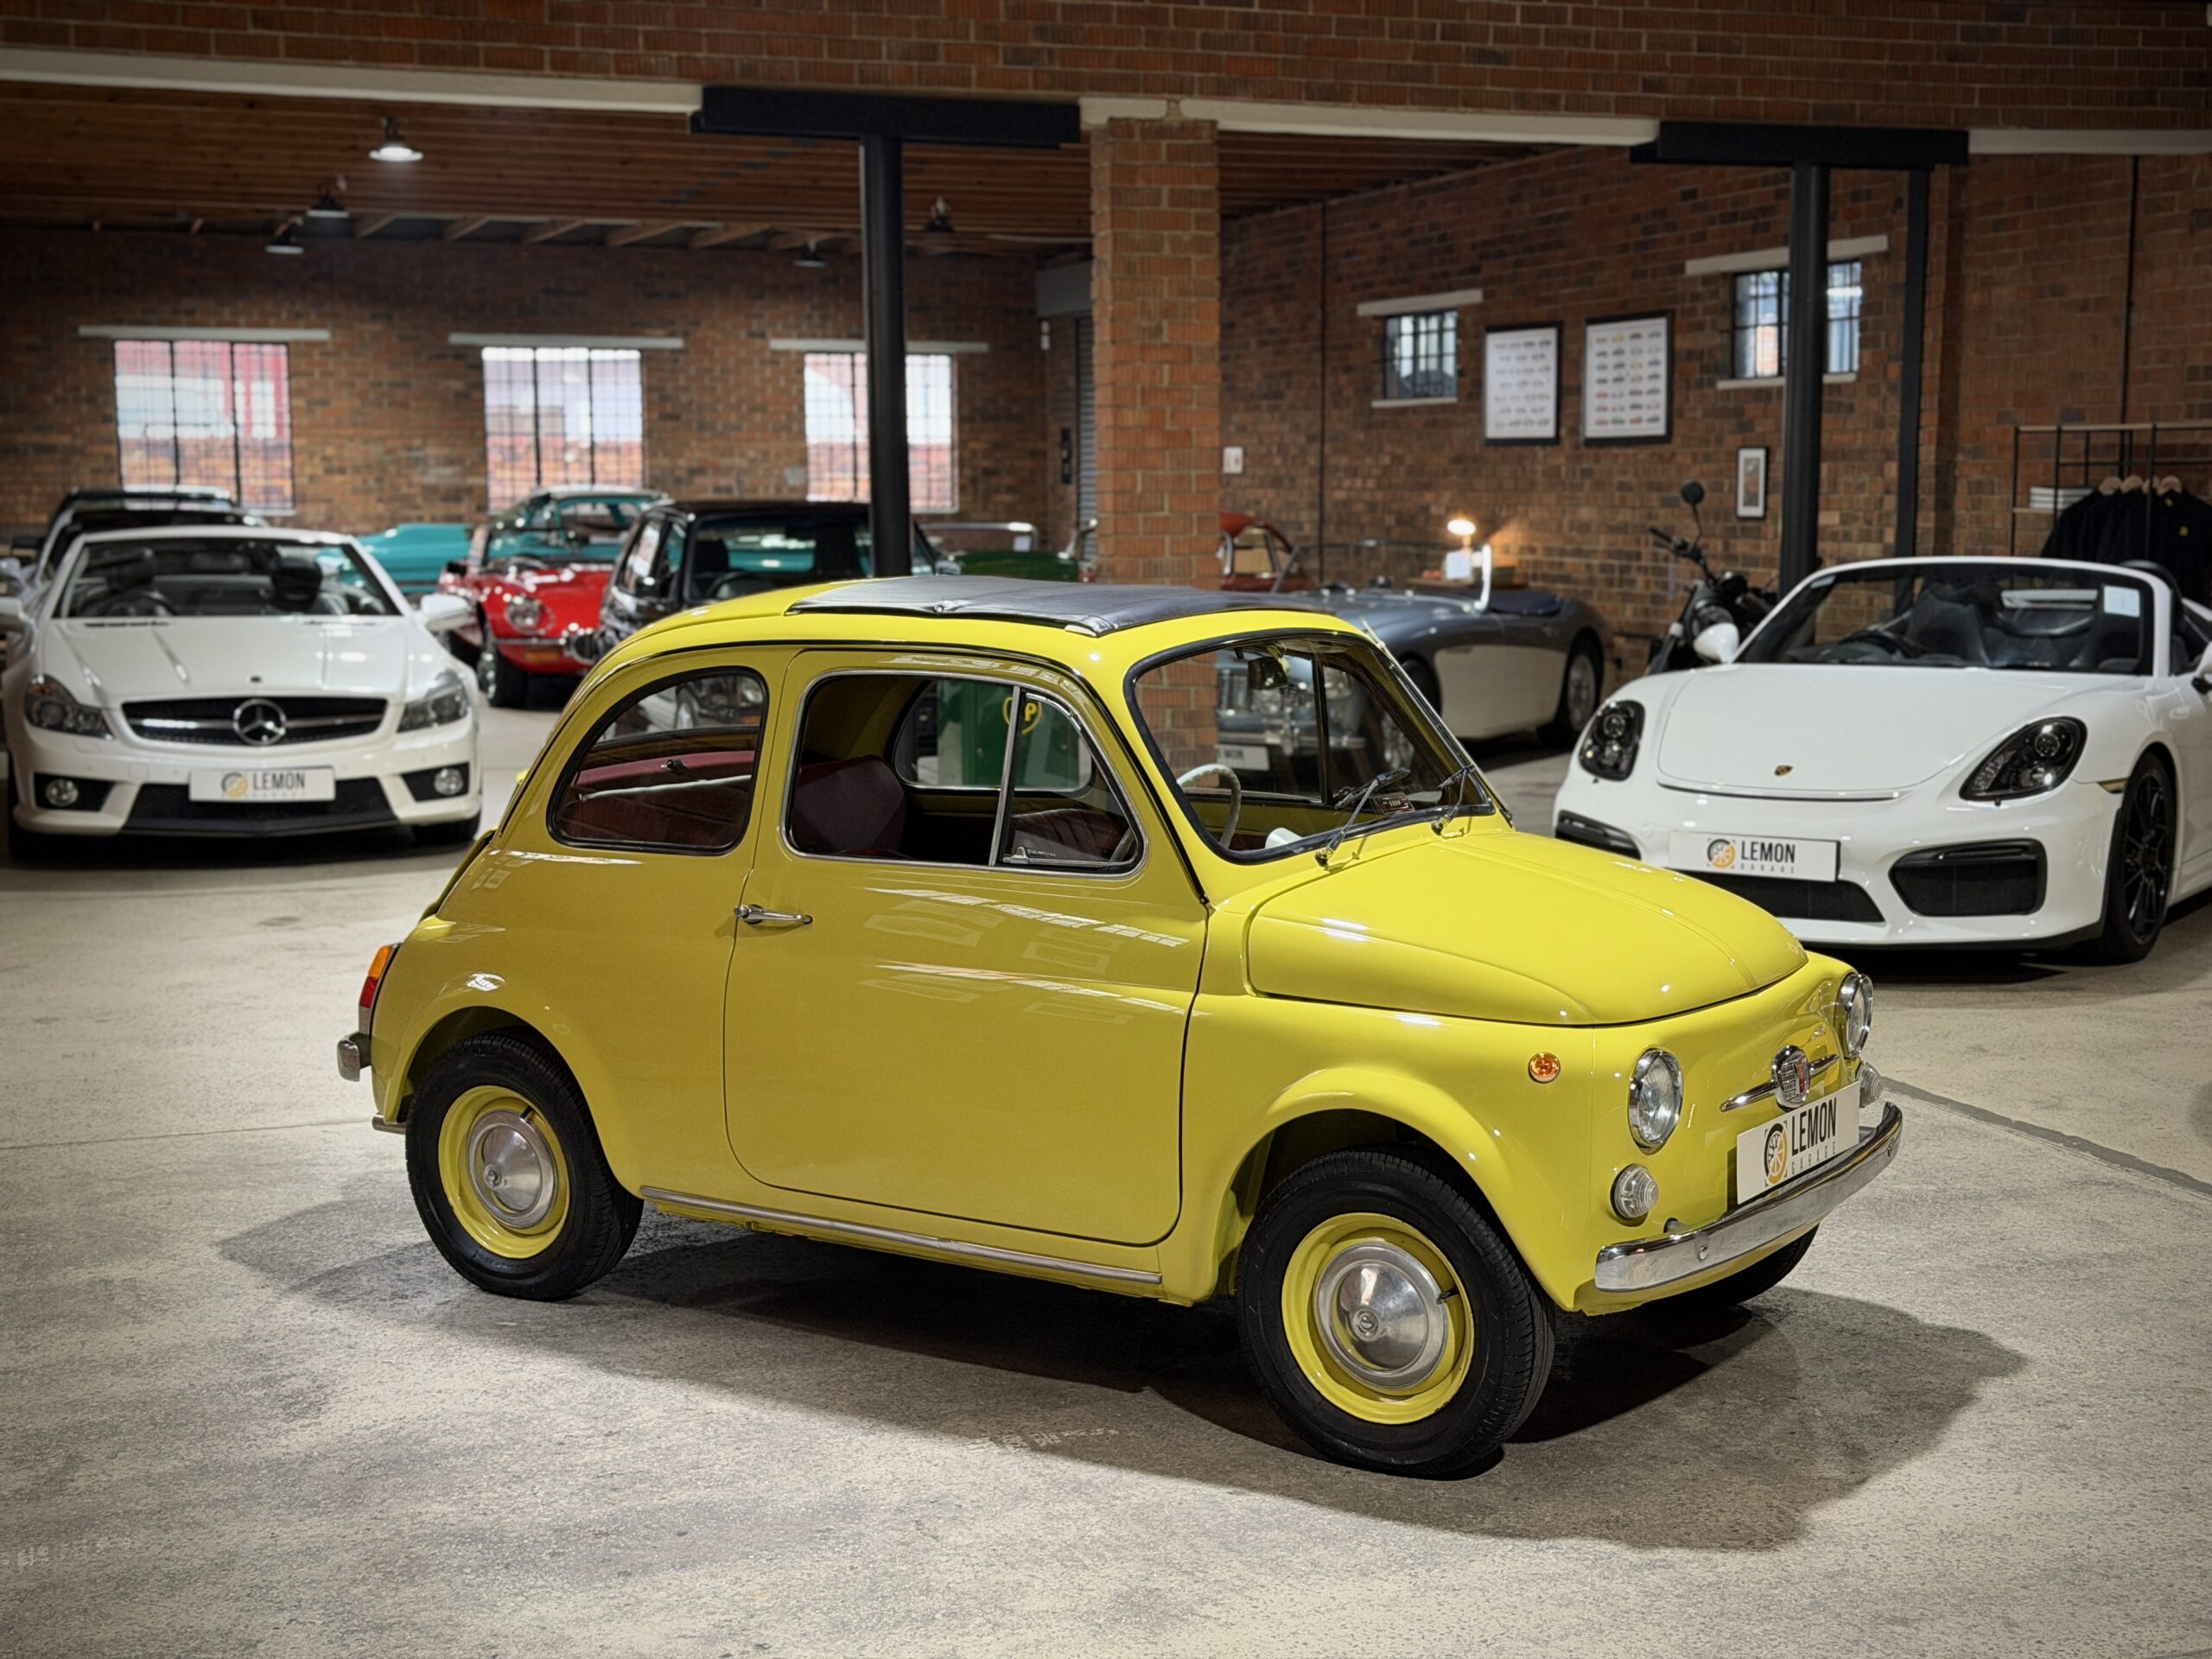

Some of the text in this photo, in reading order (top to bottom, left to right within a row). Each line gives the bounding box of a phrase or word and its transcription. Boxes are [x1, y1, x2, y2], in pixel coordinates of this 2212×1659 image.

[252, 772, 306, 791] LEMON
[1740, 840, 1796, 864] LEMON
[1791, 1096, 1837, 1156] LEMON
[1791, 1141, 1836, 1175] GARAGE
